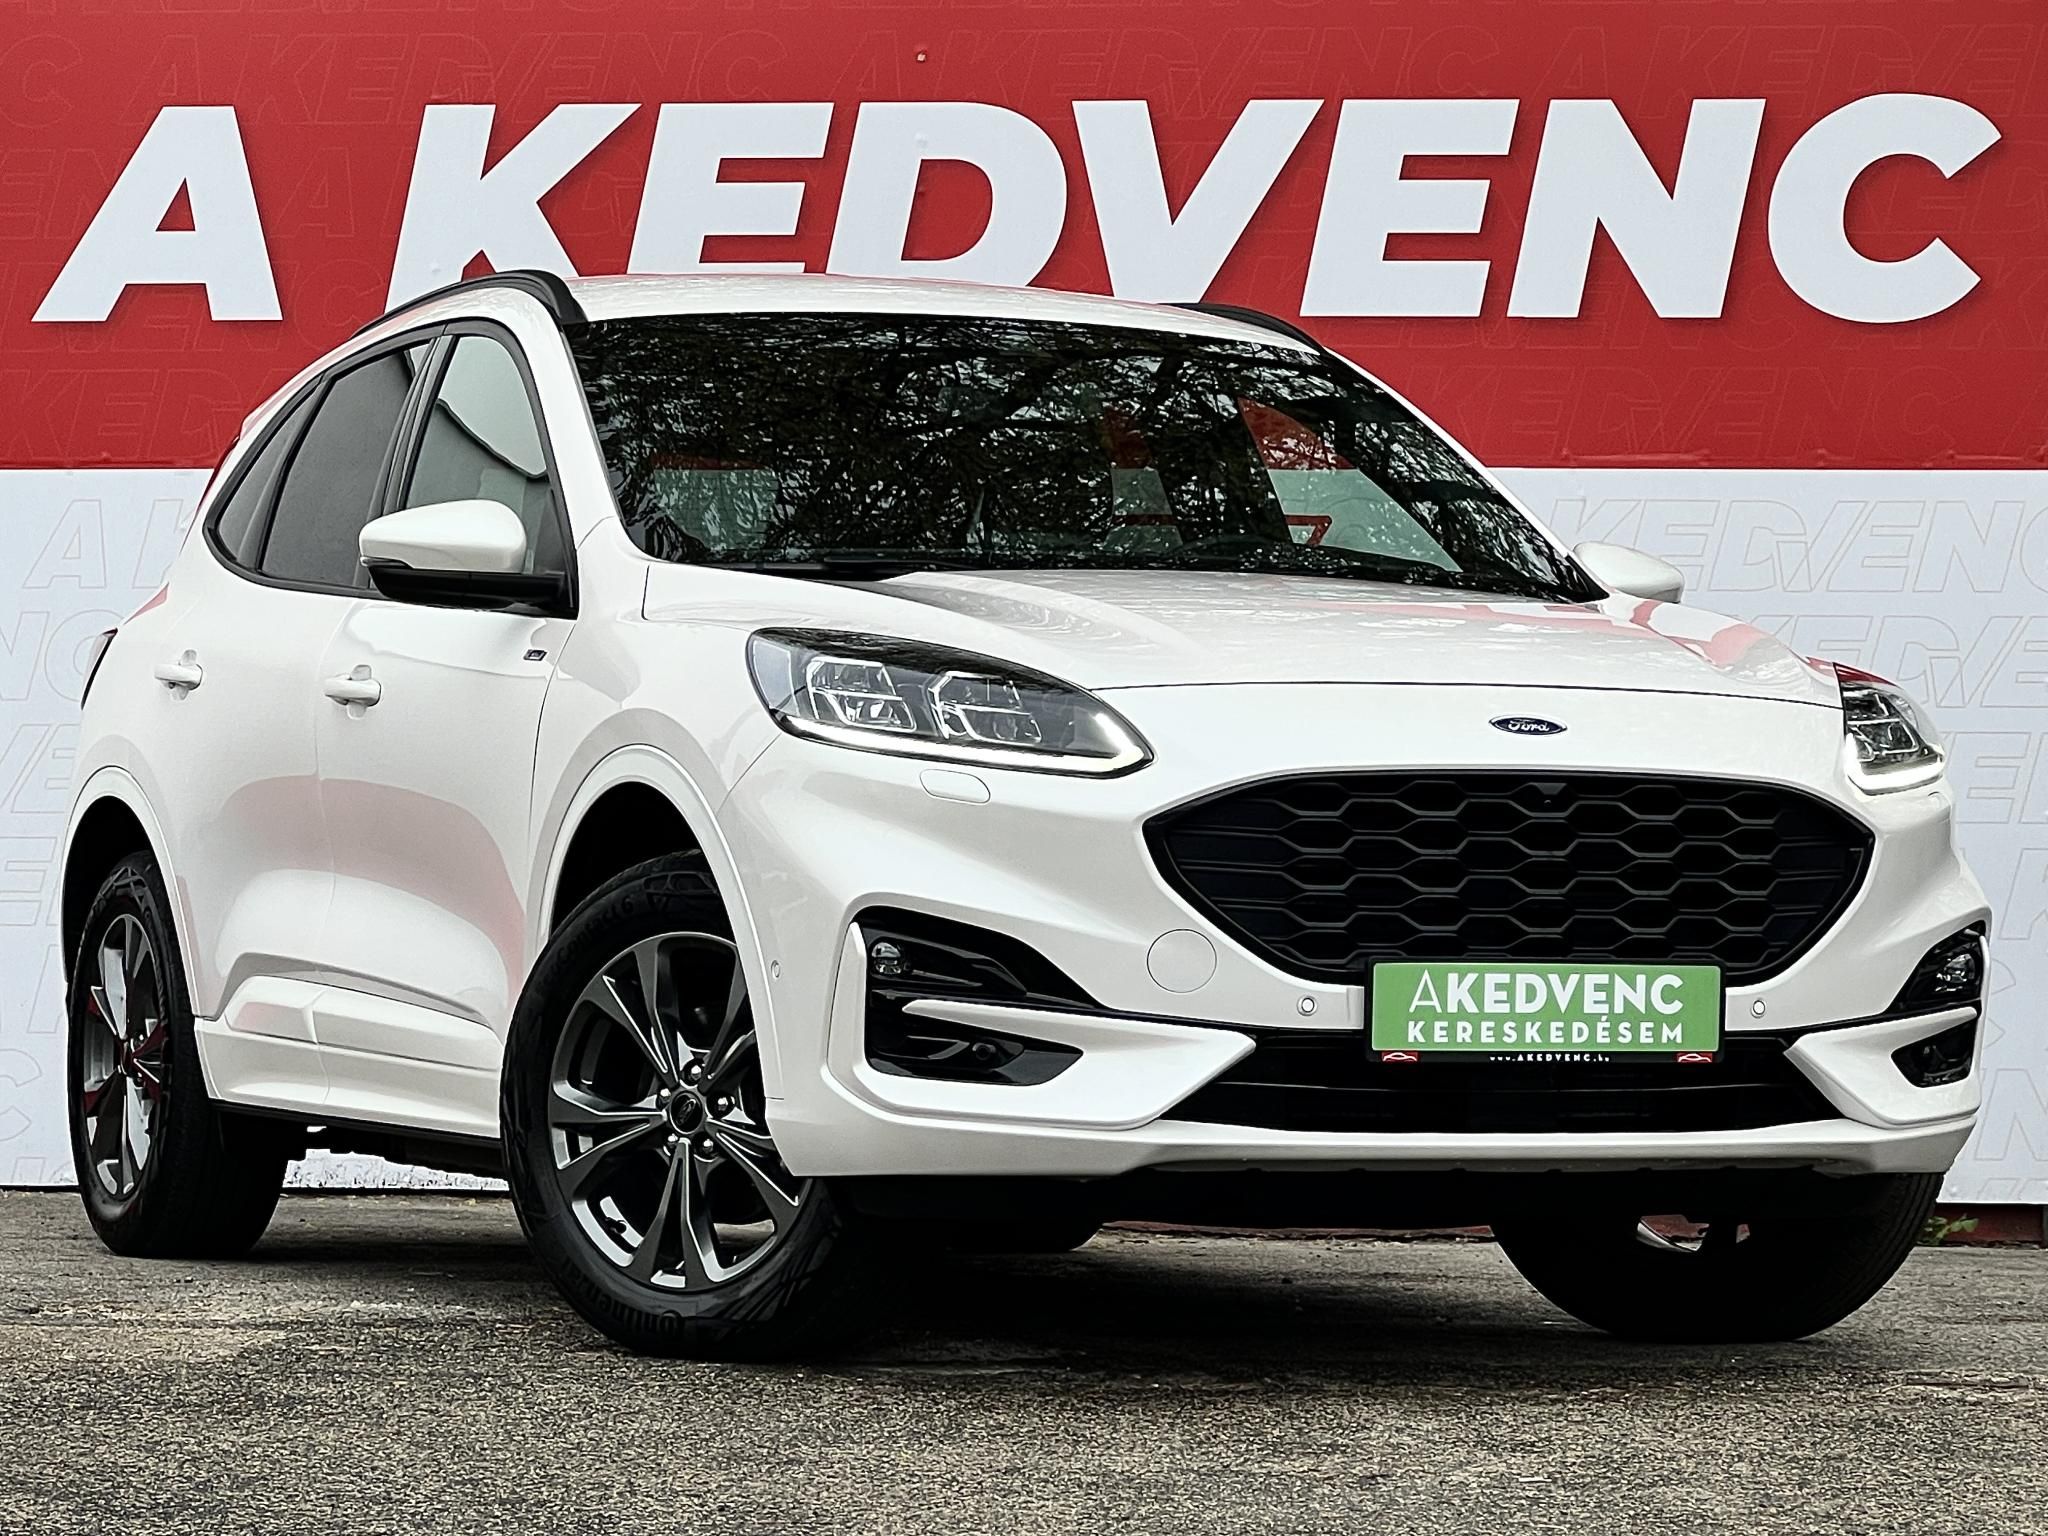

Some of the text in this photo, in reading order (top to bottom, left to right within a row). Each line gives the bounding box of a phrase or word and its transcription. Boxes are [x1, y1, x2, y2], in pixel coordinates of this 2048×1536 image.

[32, 105, 283, 322] A
[385, 93, 2002, 324] KEDVENC
[1507, 718, 1550, 732] Ford
[1407, 1015, 1683, 1044] KERESKEDÉSEM
